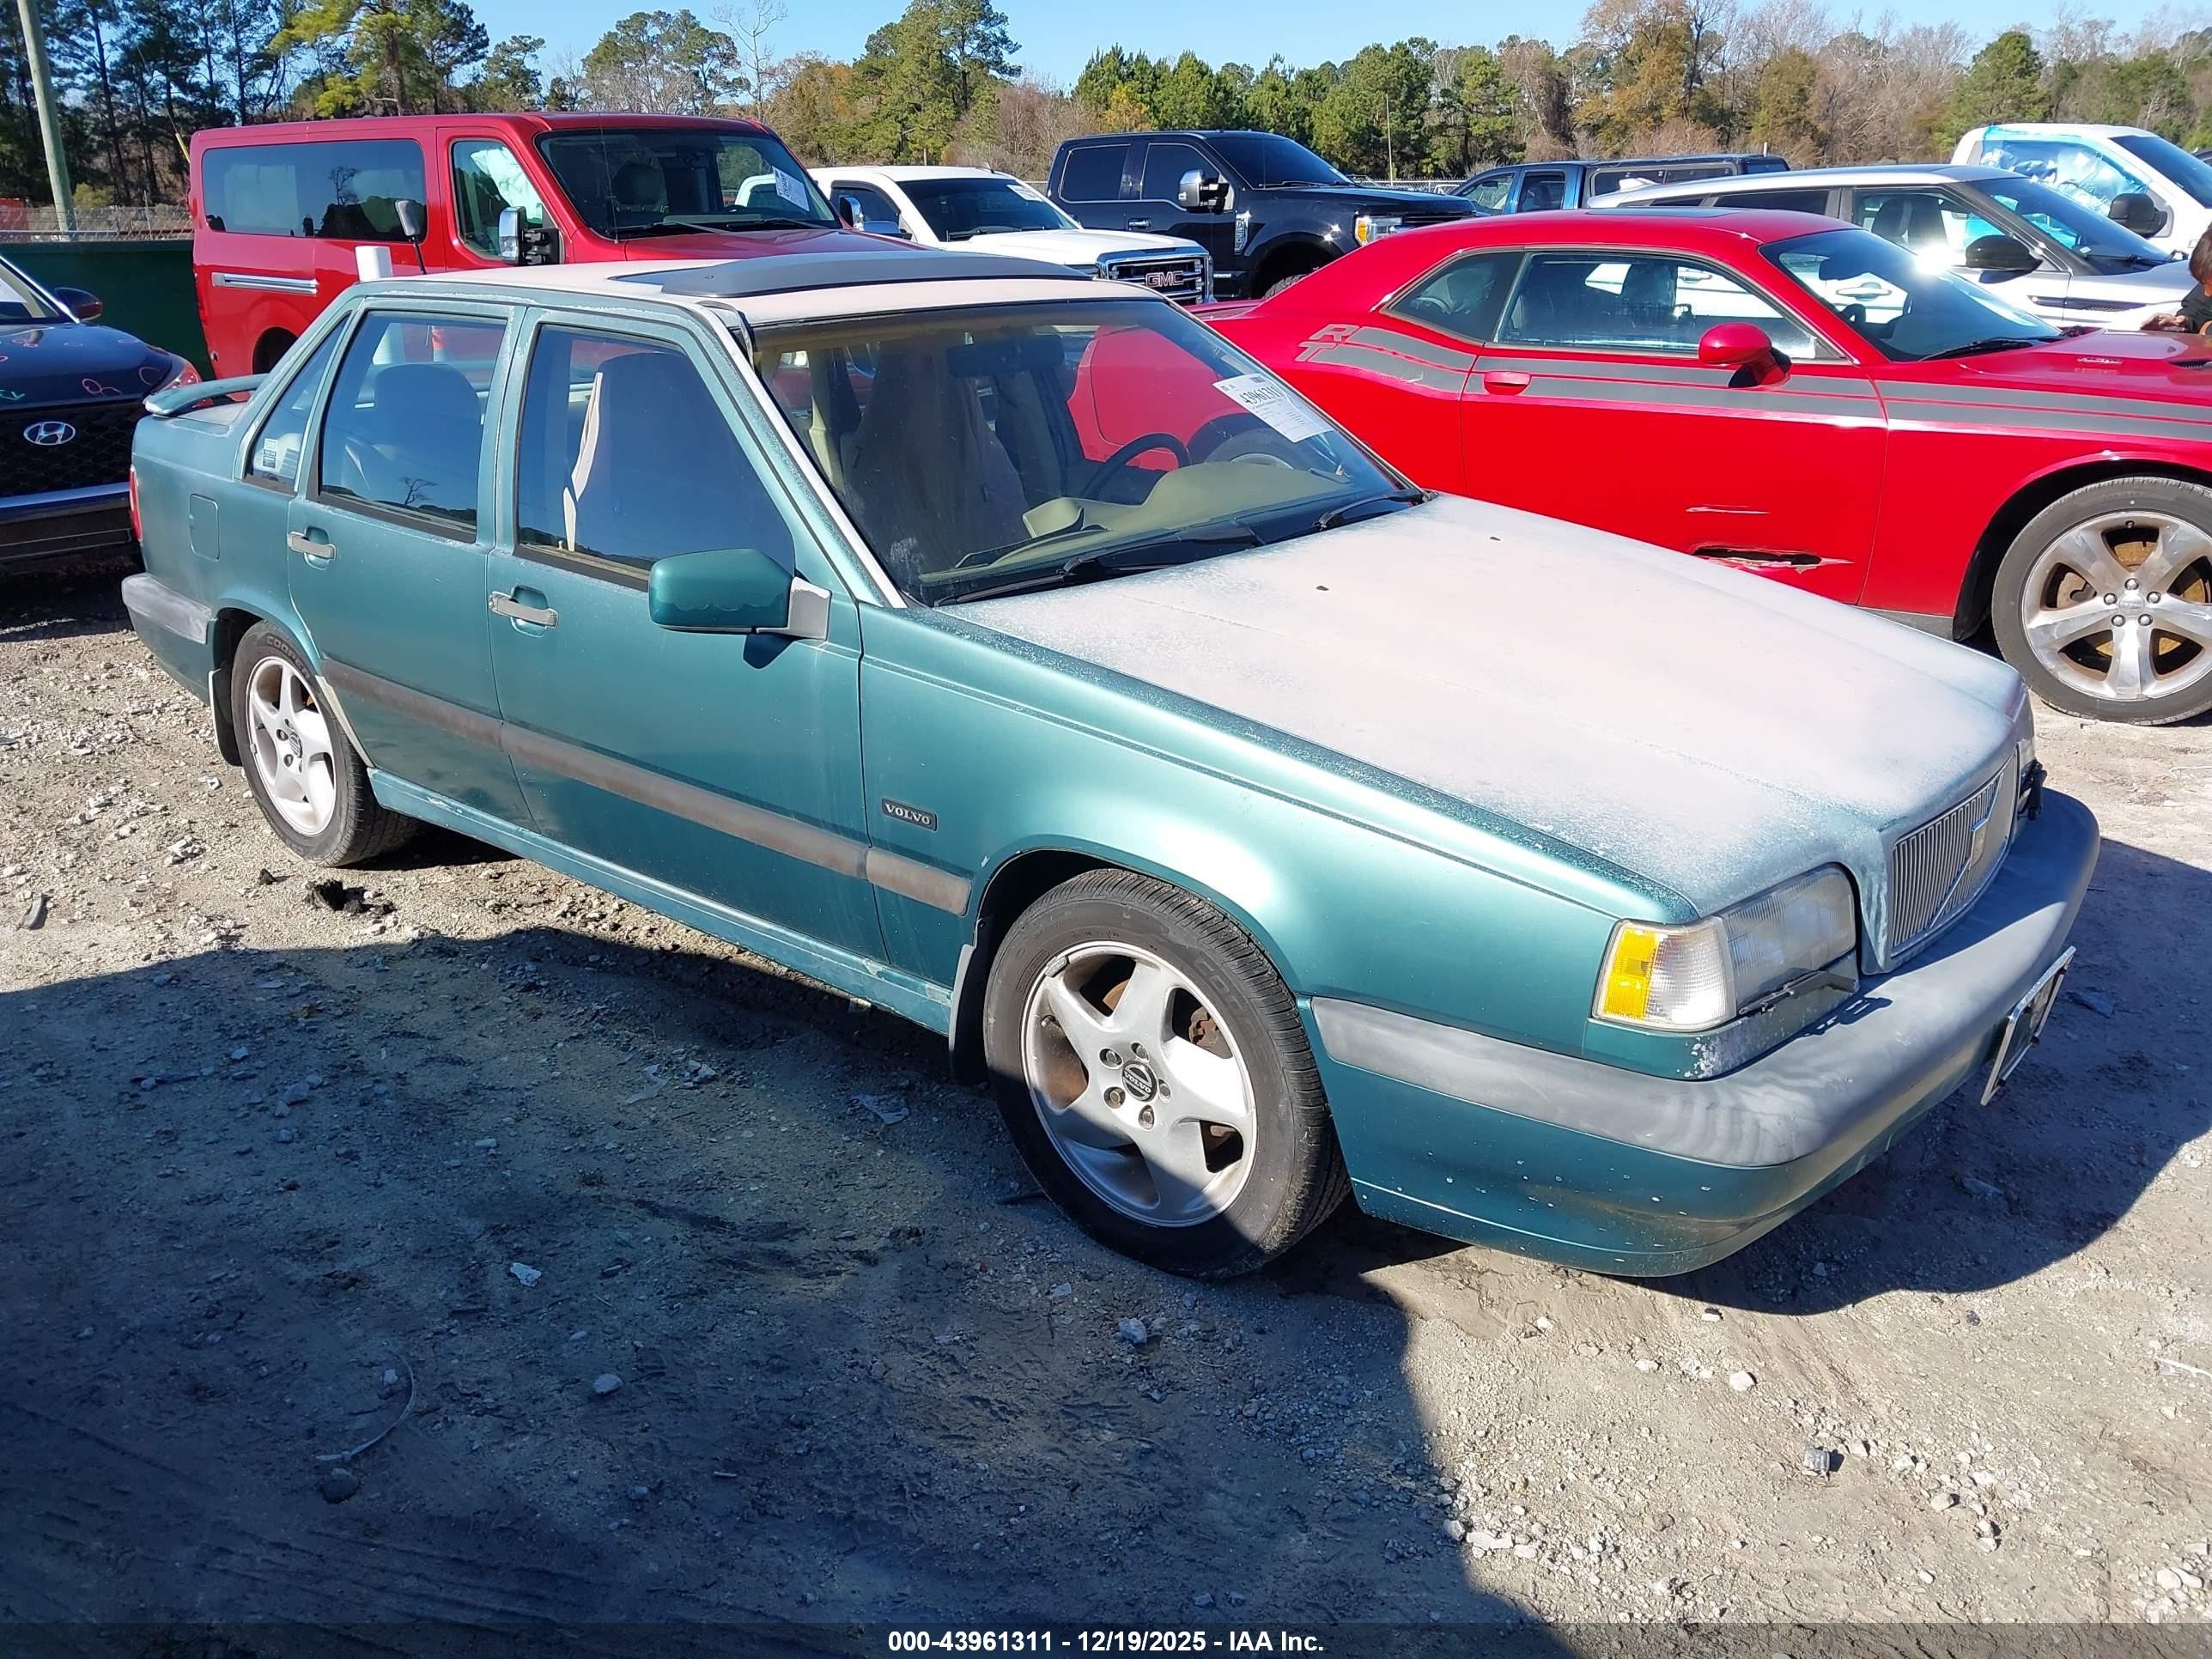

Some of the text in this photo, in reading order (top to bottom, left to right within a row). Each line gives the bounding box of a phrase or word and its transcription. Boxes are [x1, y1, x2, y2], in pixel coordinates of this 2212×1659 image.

[1146, 270, 1183, 288] GMC
[1239, 386, 1285, 404] 43961311
[267, 636, 310, 678] COOPER
[884, 802, 931, 825] VOLVO
[1123, 1070, 1152, 1093] VOLVO
